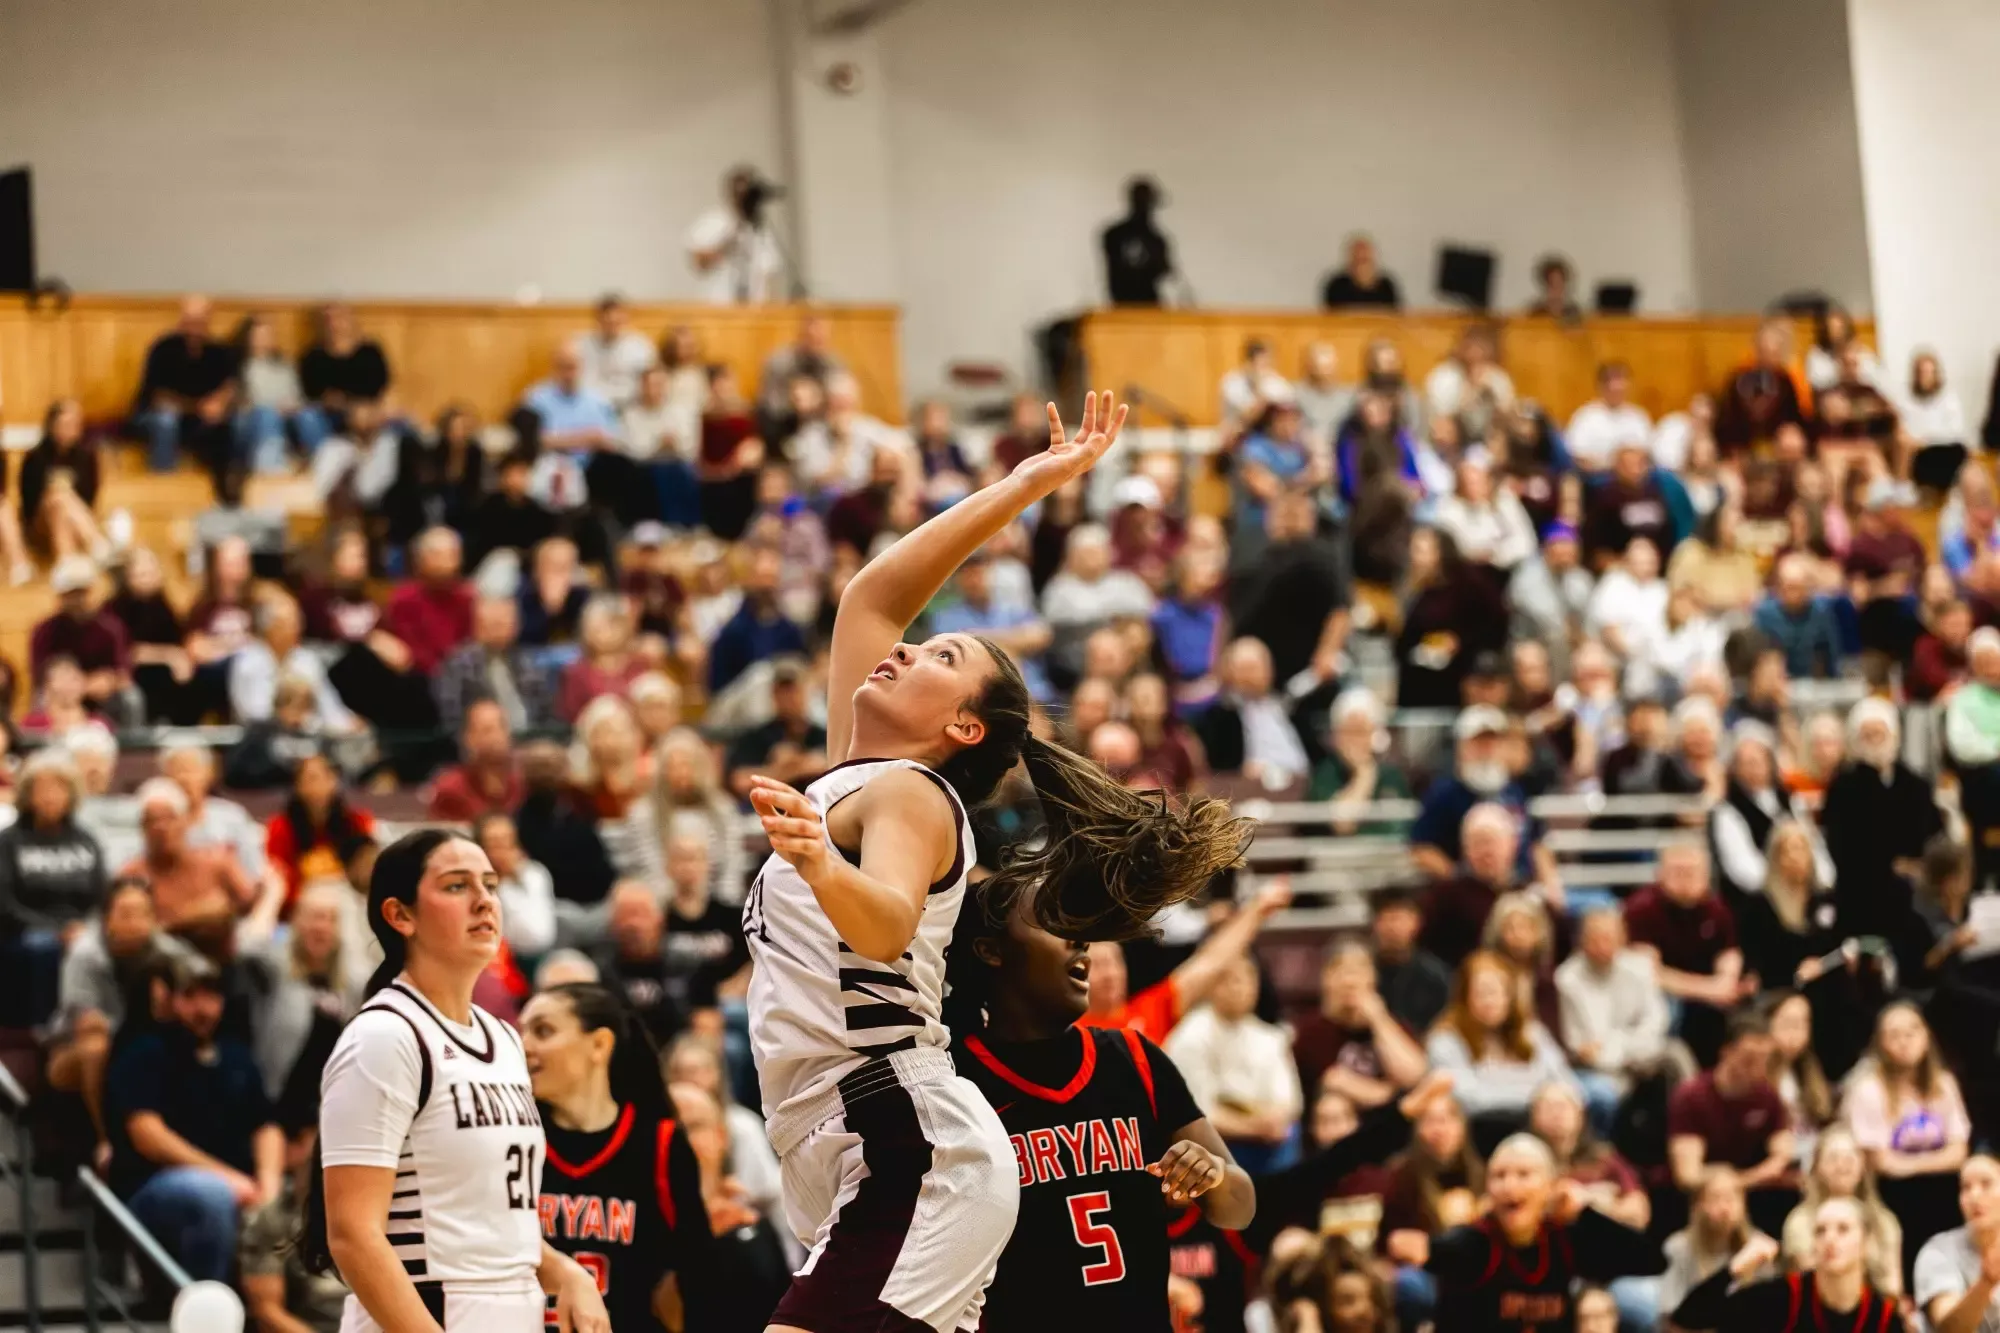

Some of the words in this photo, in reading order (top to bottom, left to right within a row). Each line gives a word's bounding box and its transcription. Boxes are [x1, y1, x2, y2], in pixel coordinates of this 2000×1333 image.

[450, 1081, 512, 1129] LADY
[506, 1144, 537, 1209] 21
[1009, 1117, 1144, 1187] BRYAN
[537, 1193, 637, 1246] RYAN
[1066, 1190, 1126, 1287] 5
